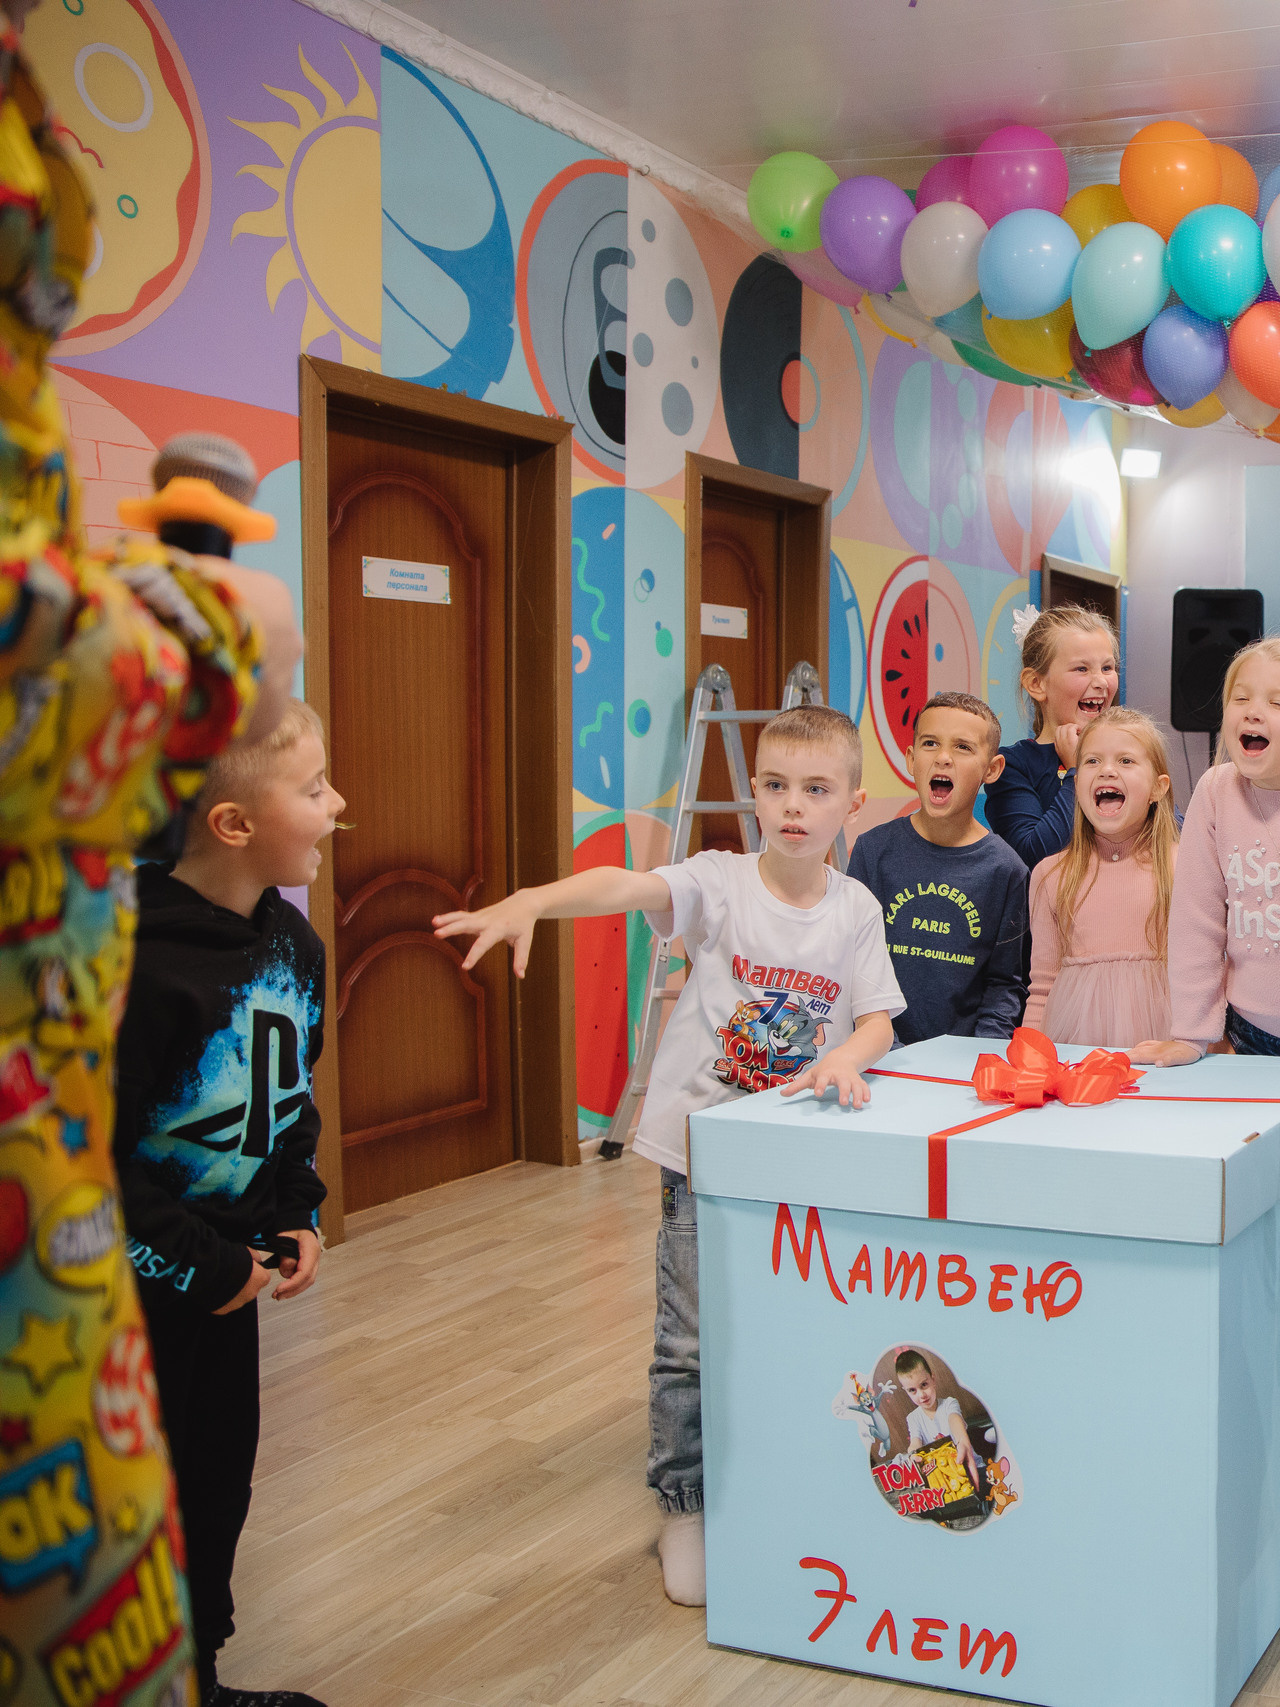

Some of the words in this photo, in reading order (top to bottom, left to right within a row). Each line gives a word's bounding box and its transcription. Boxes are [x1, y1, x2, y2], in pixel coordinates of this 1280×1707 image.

[386, 581, 428, 592] персонала
[389, 567, 425, 580] Комната
[886, 887, 915, 925] KARL
[917, 882, 982, 938] LAGERFELD
[911, 917, 951, 934] PARIS
[893, 945, 908, 955] RUE
[910, 947, 976, 965] ST-GUILLAUME
[757, 990, 790, 1025] 7
[715, 1026, 769, 1070] TOM
[872, 1460, 925, 1494] TOM
[897, 1487, 946, 1516] JERRY
[798, 1555, 858, 1643] 7
